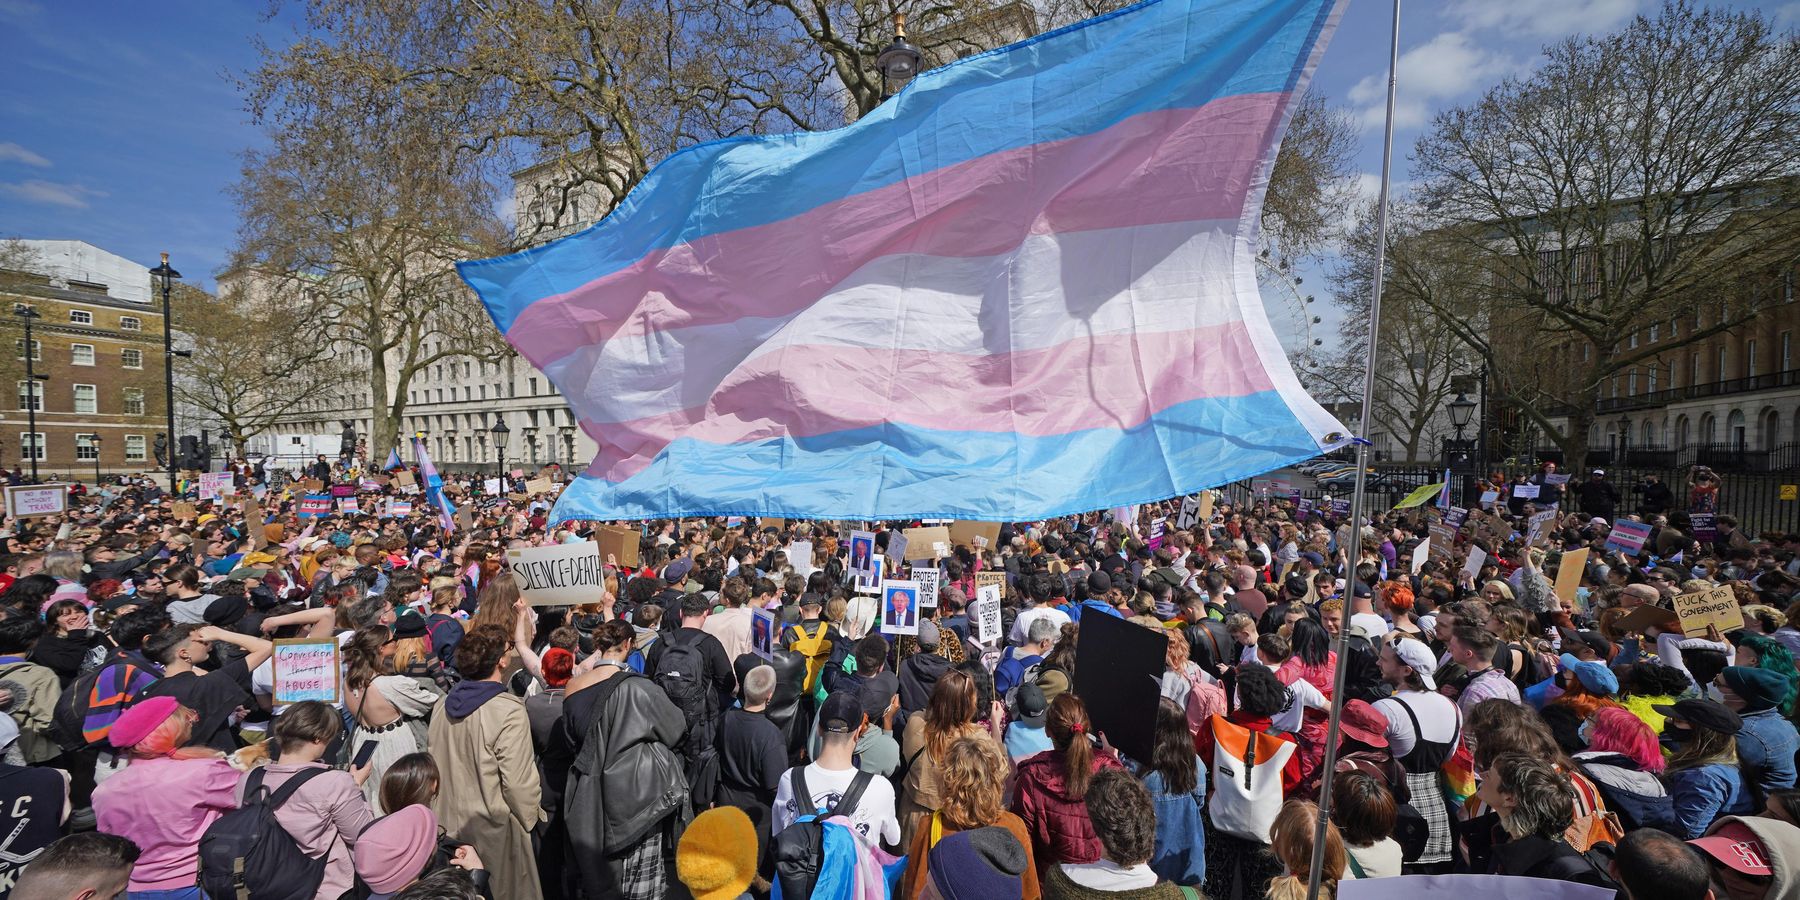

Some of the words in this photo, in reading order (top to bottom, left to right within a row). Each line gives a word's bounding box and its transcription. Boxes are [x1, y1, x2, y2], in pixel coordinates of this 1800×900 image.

[200, 480, 225, 489] TRANS
[28, 503, 56, 512] TRANS
[513, 554, 603, 591] SILENCE=DEATH
[913, 571, 938, 583] PROTECT
[977, 573, 1006, 581] PROTECT
[920, 582, 934, 593] RANS
[920, 593, 933, 604] OUTH
[1675, 593, 1708, 607] FUCK
[1709, 589, 1728, 600] THIS
[1679, 600, 1734, 618] GOVERNMENT
[280, 647, 331, 661] Conversion
[285, 681, 319, 691] ABUSE
